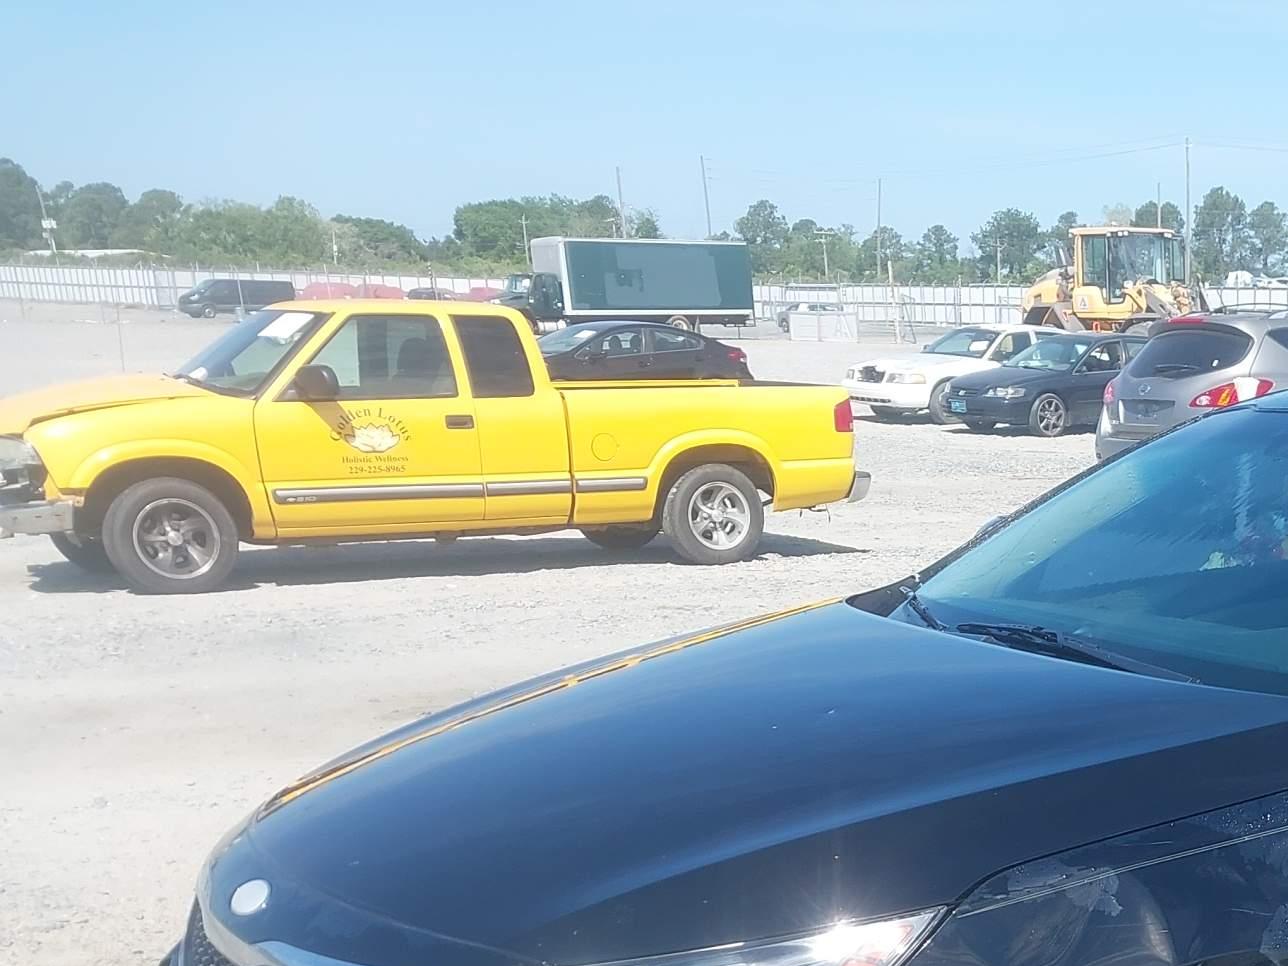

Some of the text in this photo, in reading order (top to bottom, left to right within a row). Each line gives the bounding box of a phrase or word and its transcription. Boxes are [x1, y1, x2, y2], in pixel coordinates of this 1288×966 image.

[329, 407, 412, 441] Golden Lotus
[341, 455, 409, 464] Holistic Wellness
[348, 465, 407, 474] 229-225-8965
